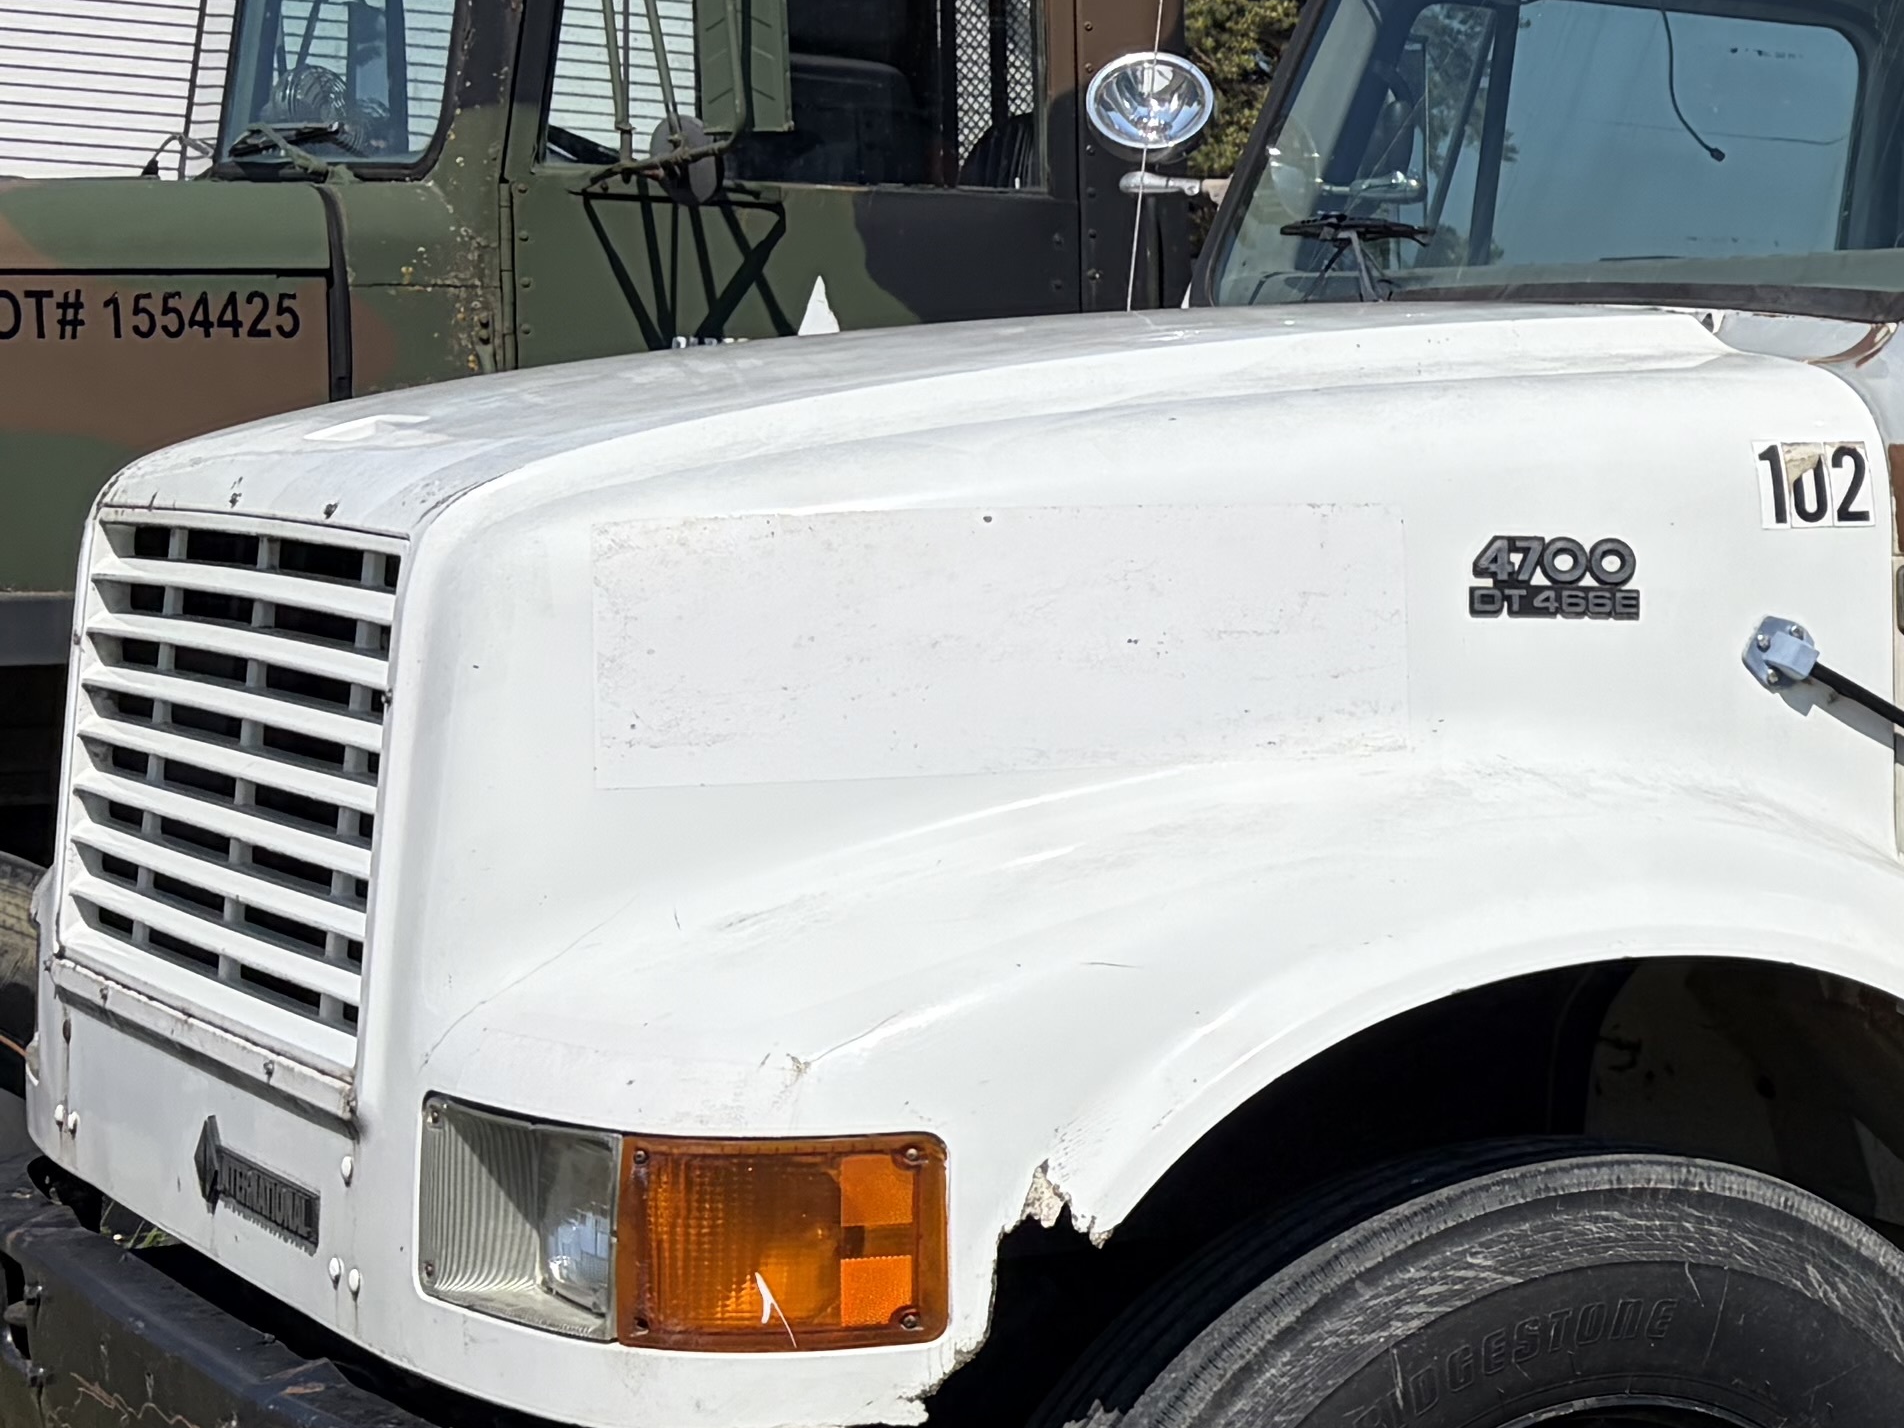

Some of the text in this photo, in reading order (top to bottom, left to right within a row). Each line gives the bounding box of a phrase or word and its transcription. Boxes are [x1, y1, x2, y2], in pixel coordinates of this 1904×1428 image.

[103, 289, 301, 340] 1554425
[1472, 535, 1637, 587] 4700
[1472, 587, 1641, 617] DT 466E
